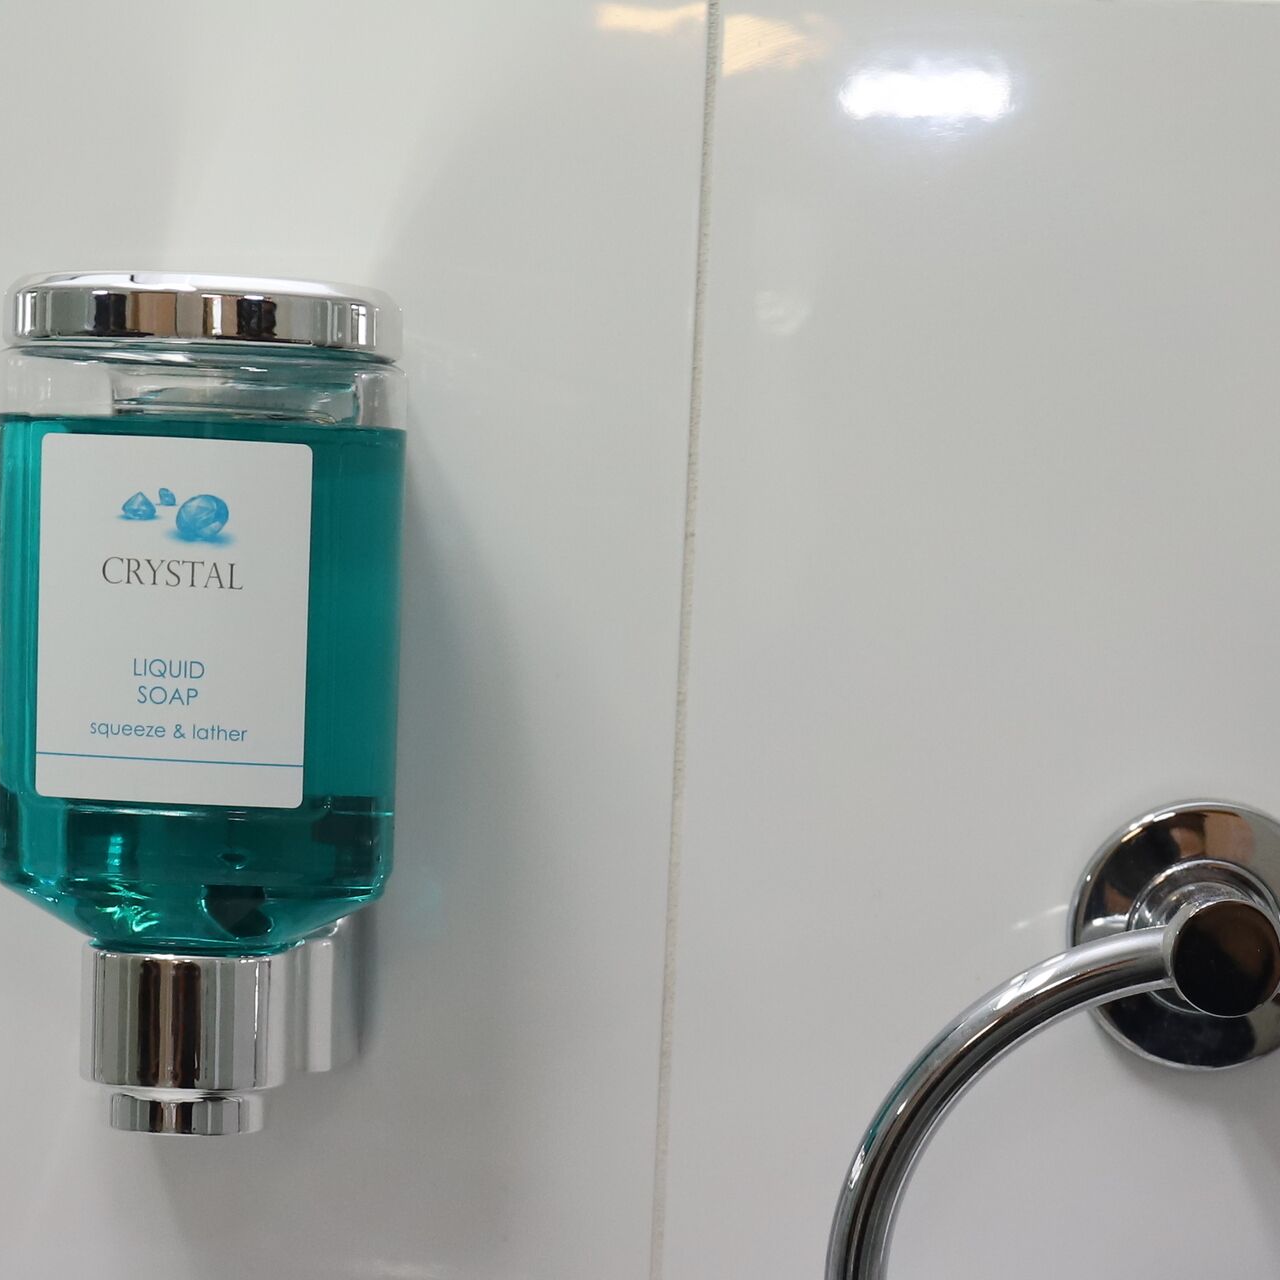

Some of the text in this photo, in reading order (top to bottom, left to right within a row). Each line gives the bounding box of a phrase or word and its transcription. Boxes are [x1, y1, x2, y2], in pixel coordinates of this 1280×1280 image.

[102, 556, 243, 590] CRYSTAL
[133, 658, 205, 679] LIQUID
[136, 685, 198, 706] SOAP
[89, 721, 248, 742] squeeze & lather
